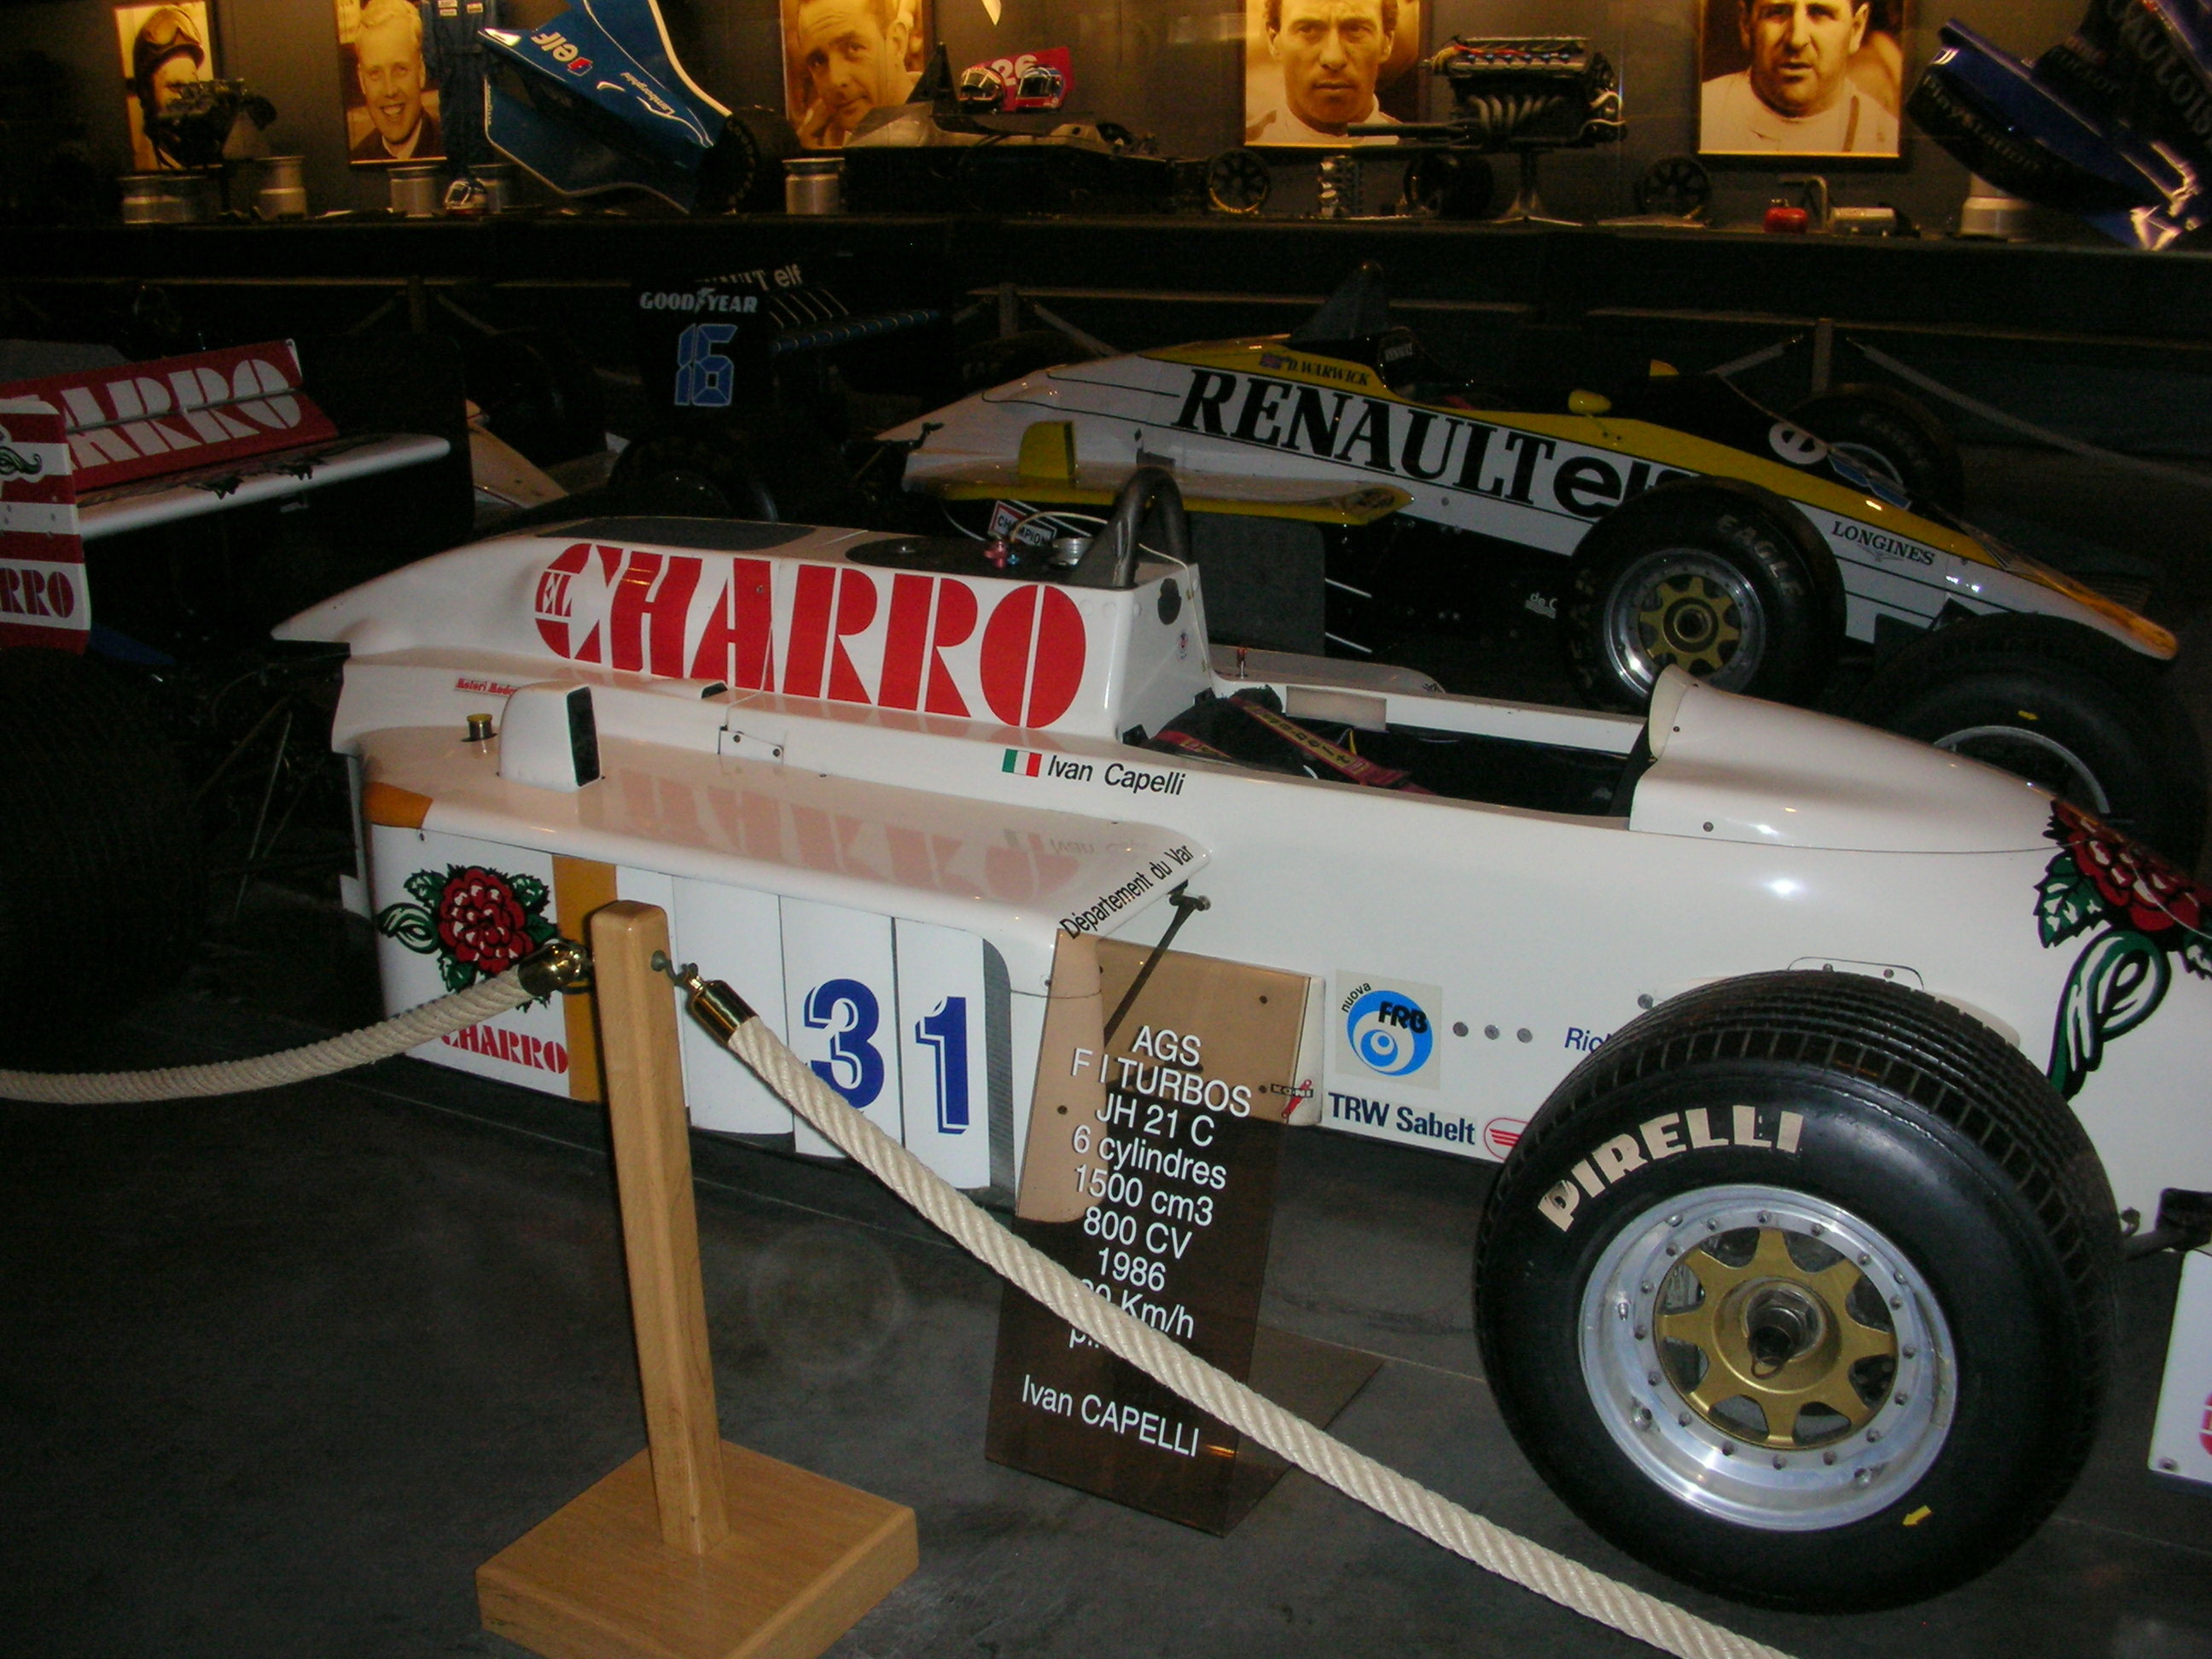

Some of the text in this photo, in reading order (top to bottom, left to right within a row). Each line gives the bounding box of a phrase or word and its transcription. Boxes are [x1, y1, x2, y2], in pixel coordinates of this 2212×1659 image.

[531, 32, 579, 61] elf
[640, 288, 758, 313] GOODYEAR
[773, 262, 803, 288] elf
[673, 323, 739, 407] 16
[1301, 361, 1371, 385] WARWICK
[0, 358, 302, 471] ARRO
[1171, 369, 1693, 517] RENAULT el
[1832, 521, 1935, 566] LONGINES
[535, 571, 572, 618] EL
[535, 543, 1086, 729] CHARRO
[1047, 753, 1186, 795] Ivan Capelli
[1059, 845, 1194, 940] Département du Var
[1341, 982, 1371, 1013] nuova
[1378, 1000, 1428, 1033] FRB
[1132, 1025, 1202, 1067] AGS
[1271, 1083, 1313, 1099] KONI
[1096, 1092, 1215, 1147] JH 21 C
[1328, 1092, 1476, 1146] TRW Sabelt
[1074, 1124, 1227, 1190] 6 cylindres
[1538, 1104, 1803, 1232] PIRELLI
[1075, 1164, 1214, 1226] 1500 cm3
[1083, 1206, 1193, 1260] 800 CV
[1098, 1247, 1167, 1292] 1986
[1121, 1289, 1194, 1340] Km/h
[1022, 1374, 1199, 1458] Ivan CAPELLI
